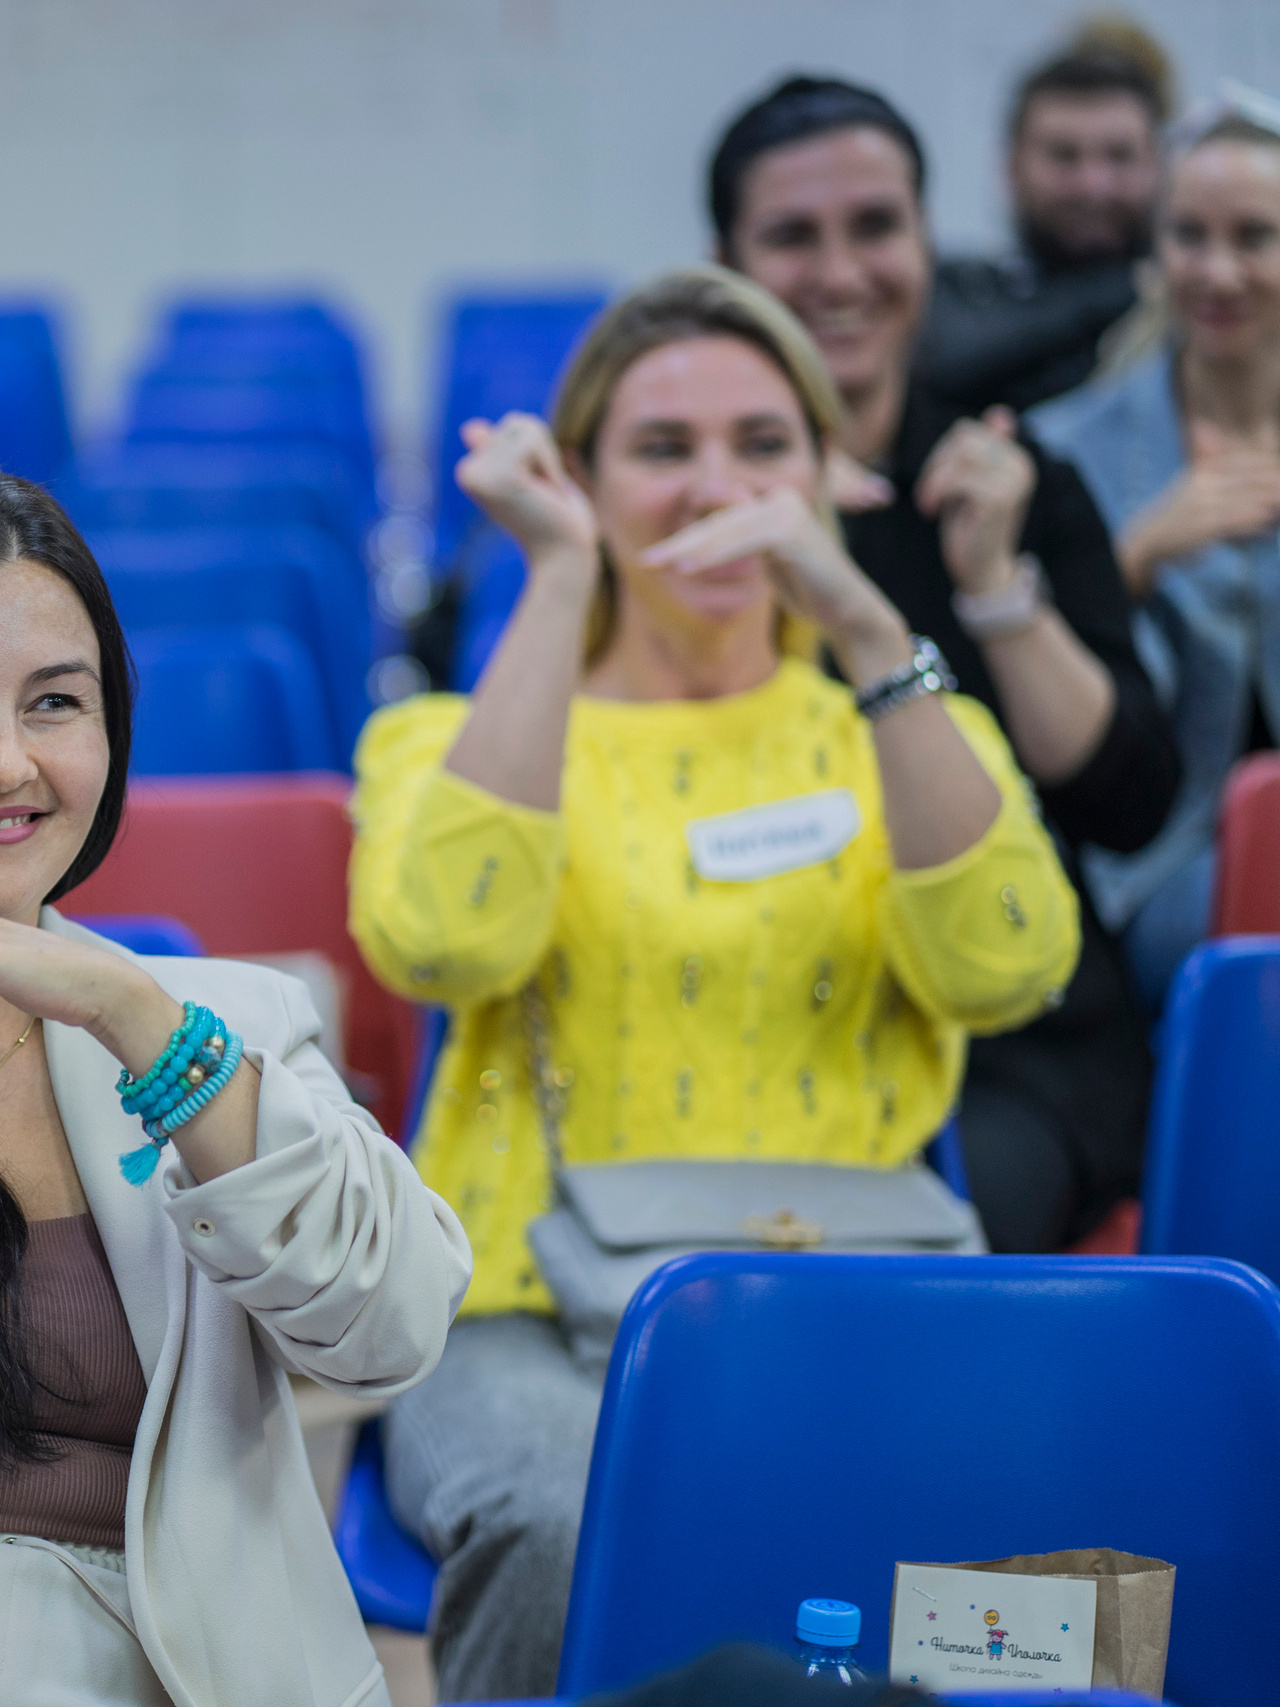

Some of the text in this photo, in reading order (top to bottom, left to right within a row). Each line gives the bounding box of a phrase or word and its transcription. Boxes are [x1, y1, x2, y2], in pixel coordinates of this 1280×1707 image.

[930, 1637, 1062, 1663] Ниточка Иголочка
[949, 1663, 976, 1674] Школа
